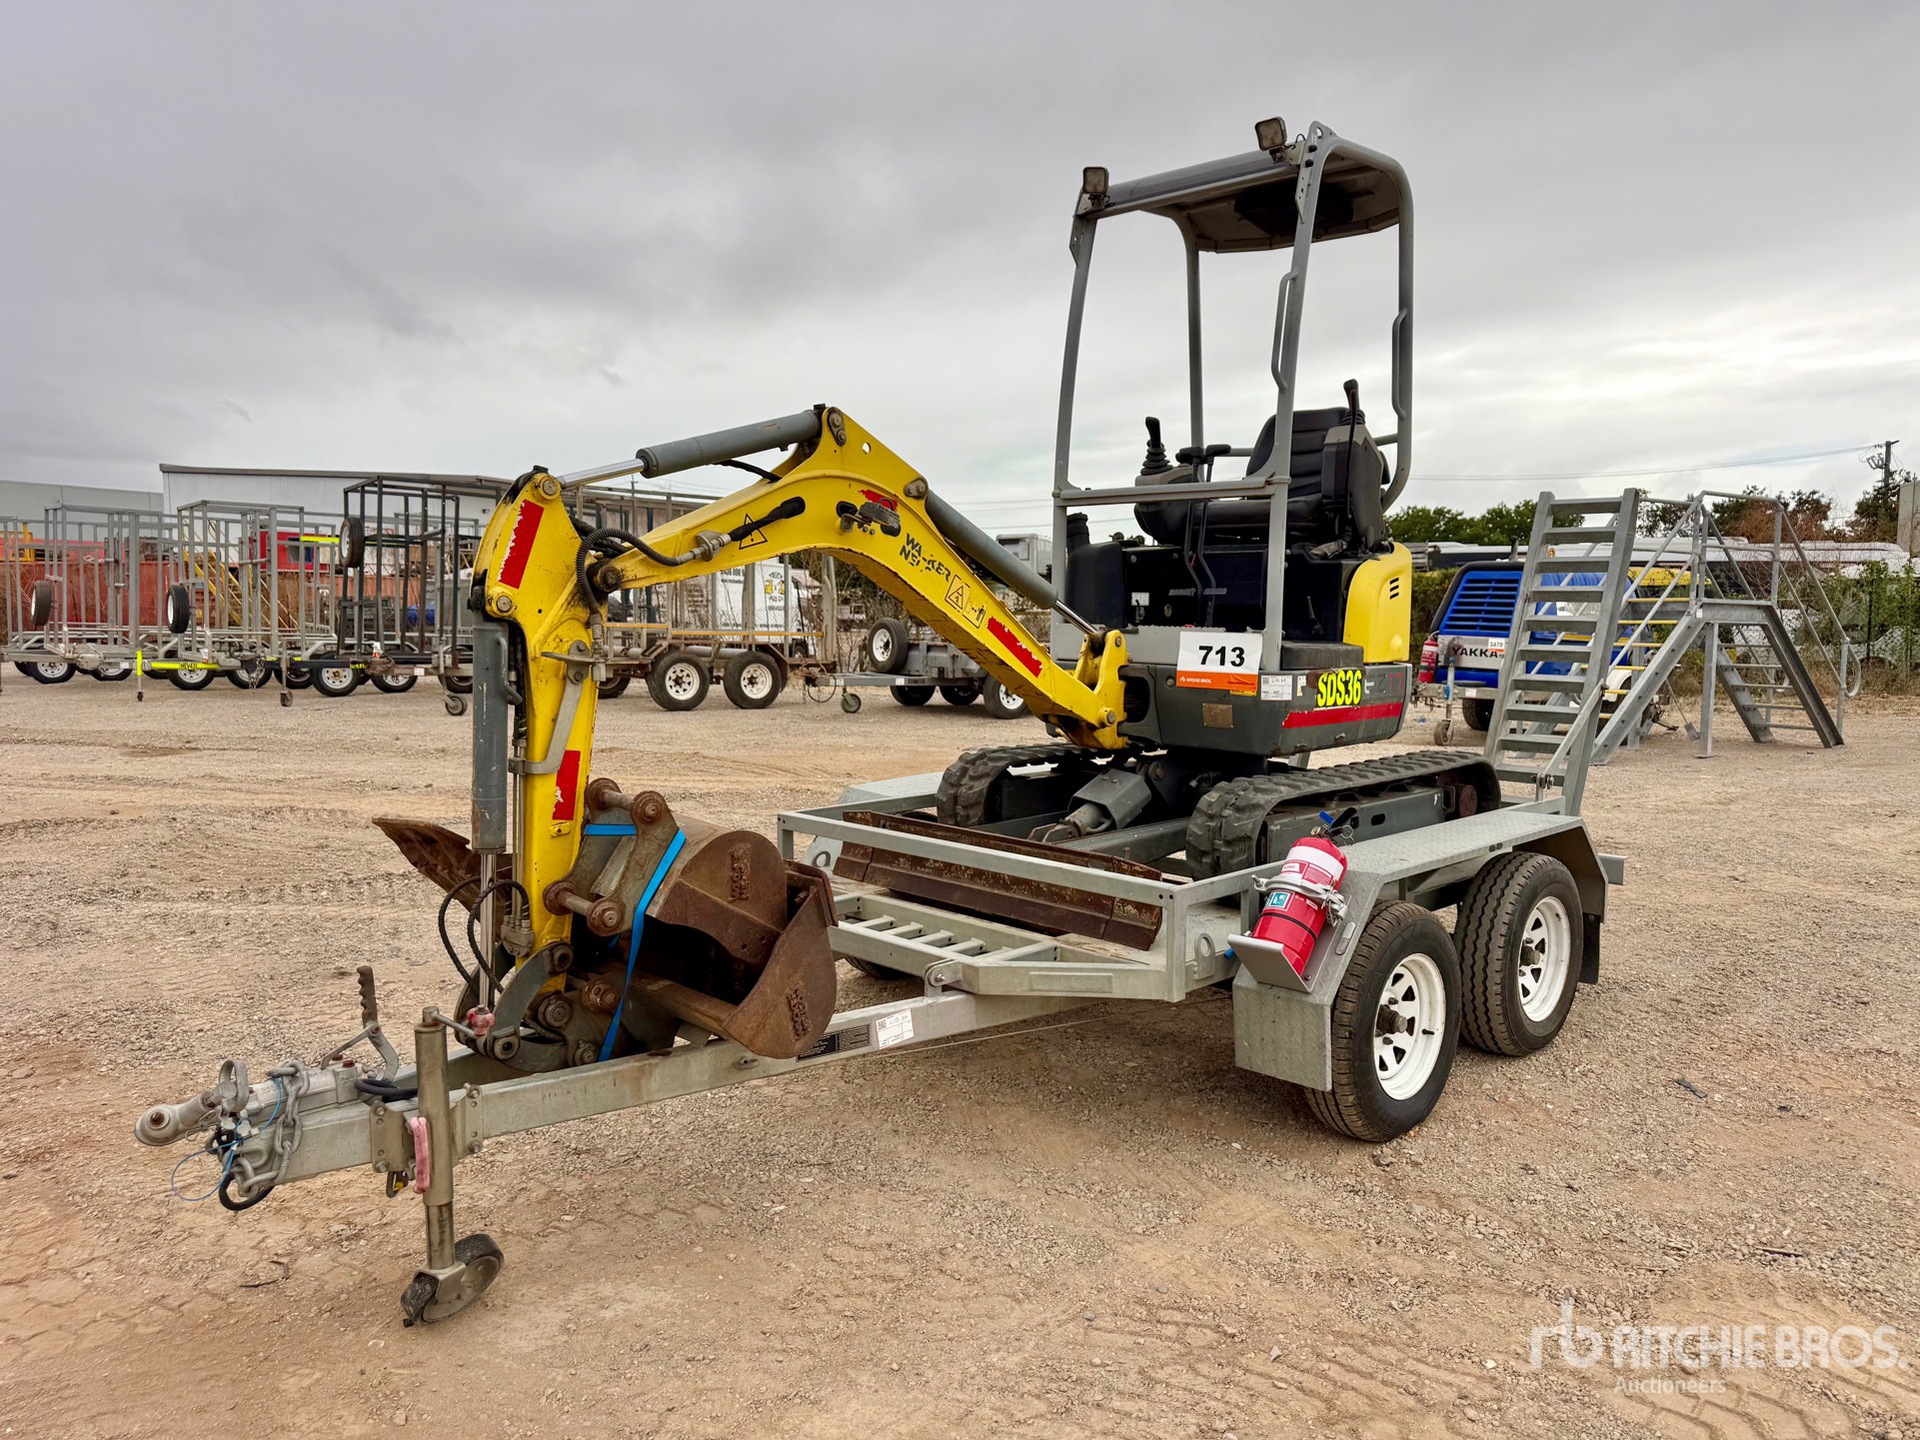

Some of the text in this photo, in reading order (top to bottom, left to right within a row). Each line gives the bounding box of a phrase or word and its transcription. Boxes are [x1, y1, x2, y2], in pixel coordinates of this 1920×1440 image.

[1199, 645, 1246, 667] 713
[1452, 647, 1498, 658] YAKKA
[1317, 669, 1362, 707] SDS36
